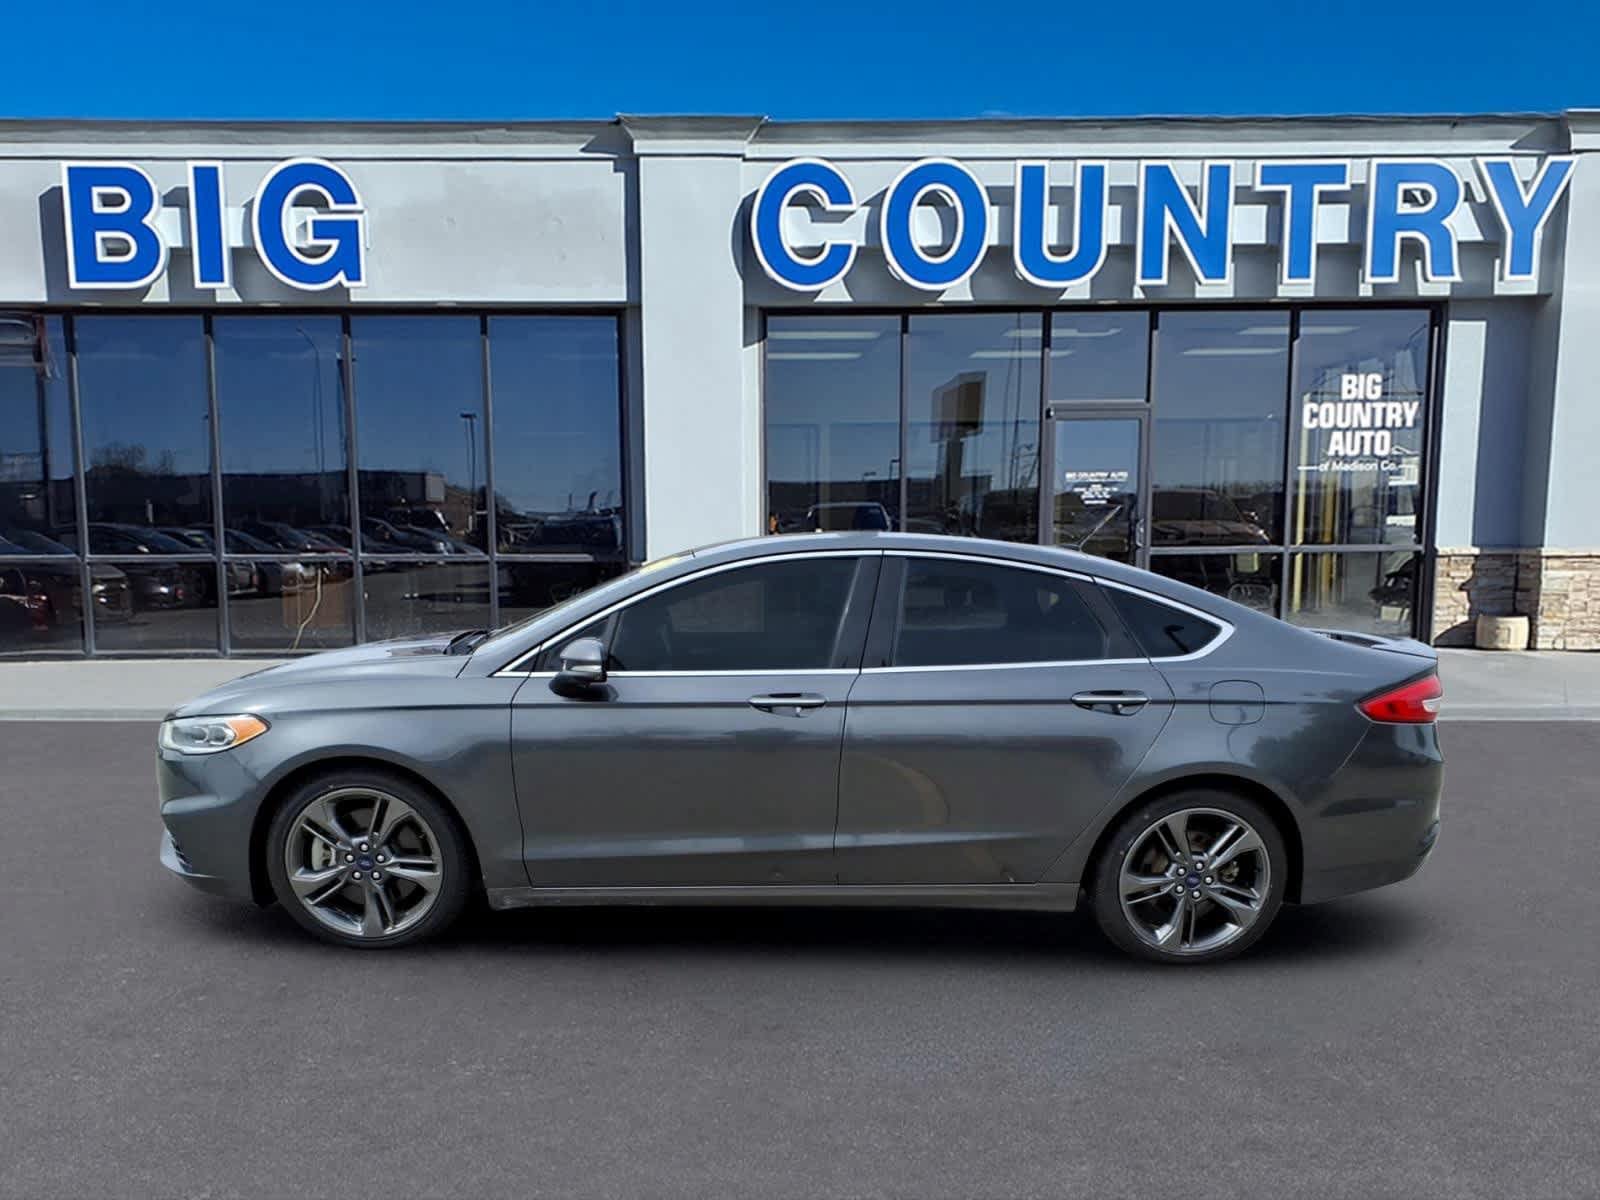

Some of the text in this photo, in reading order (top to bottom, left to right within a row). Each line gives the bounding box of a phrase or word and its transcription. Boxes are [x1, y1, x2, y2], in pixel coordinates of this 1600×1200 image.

[60, 155, 1576, 291] BIG COUNTRY
[1341, 373, 1382, 400] BIG
[1303, 401, 1419, 428] COUNTRY
[1328, 430, 1391, 456] AUTO
[1319, 461, 1330, 471] of
[1331, 461, 1378, 471] Madison
